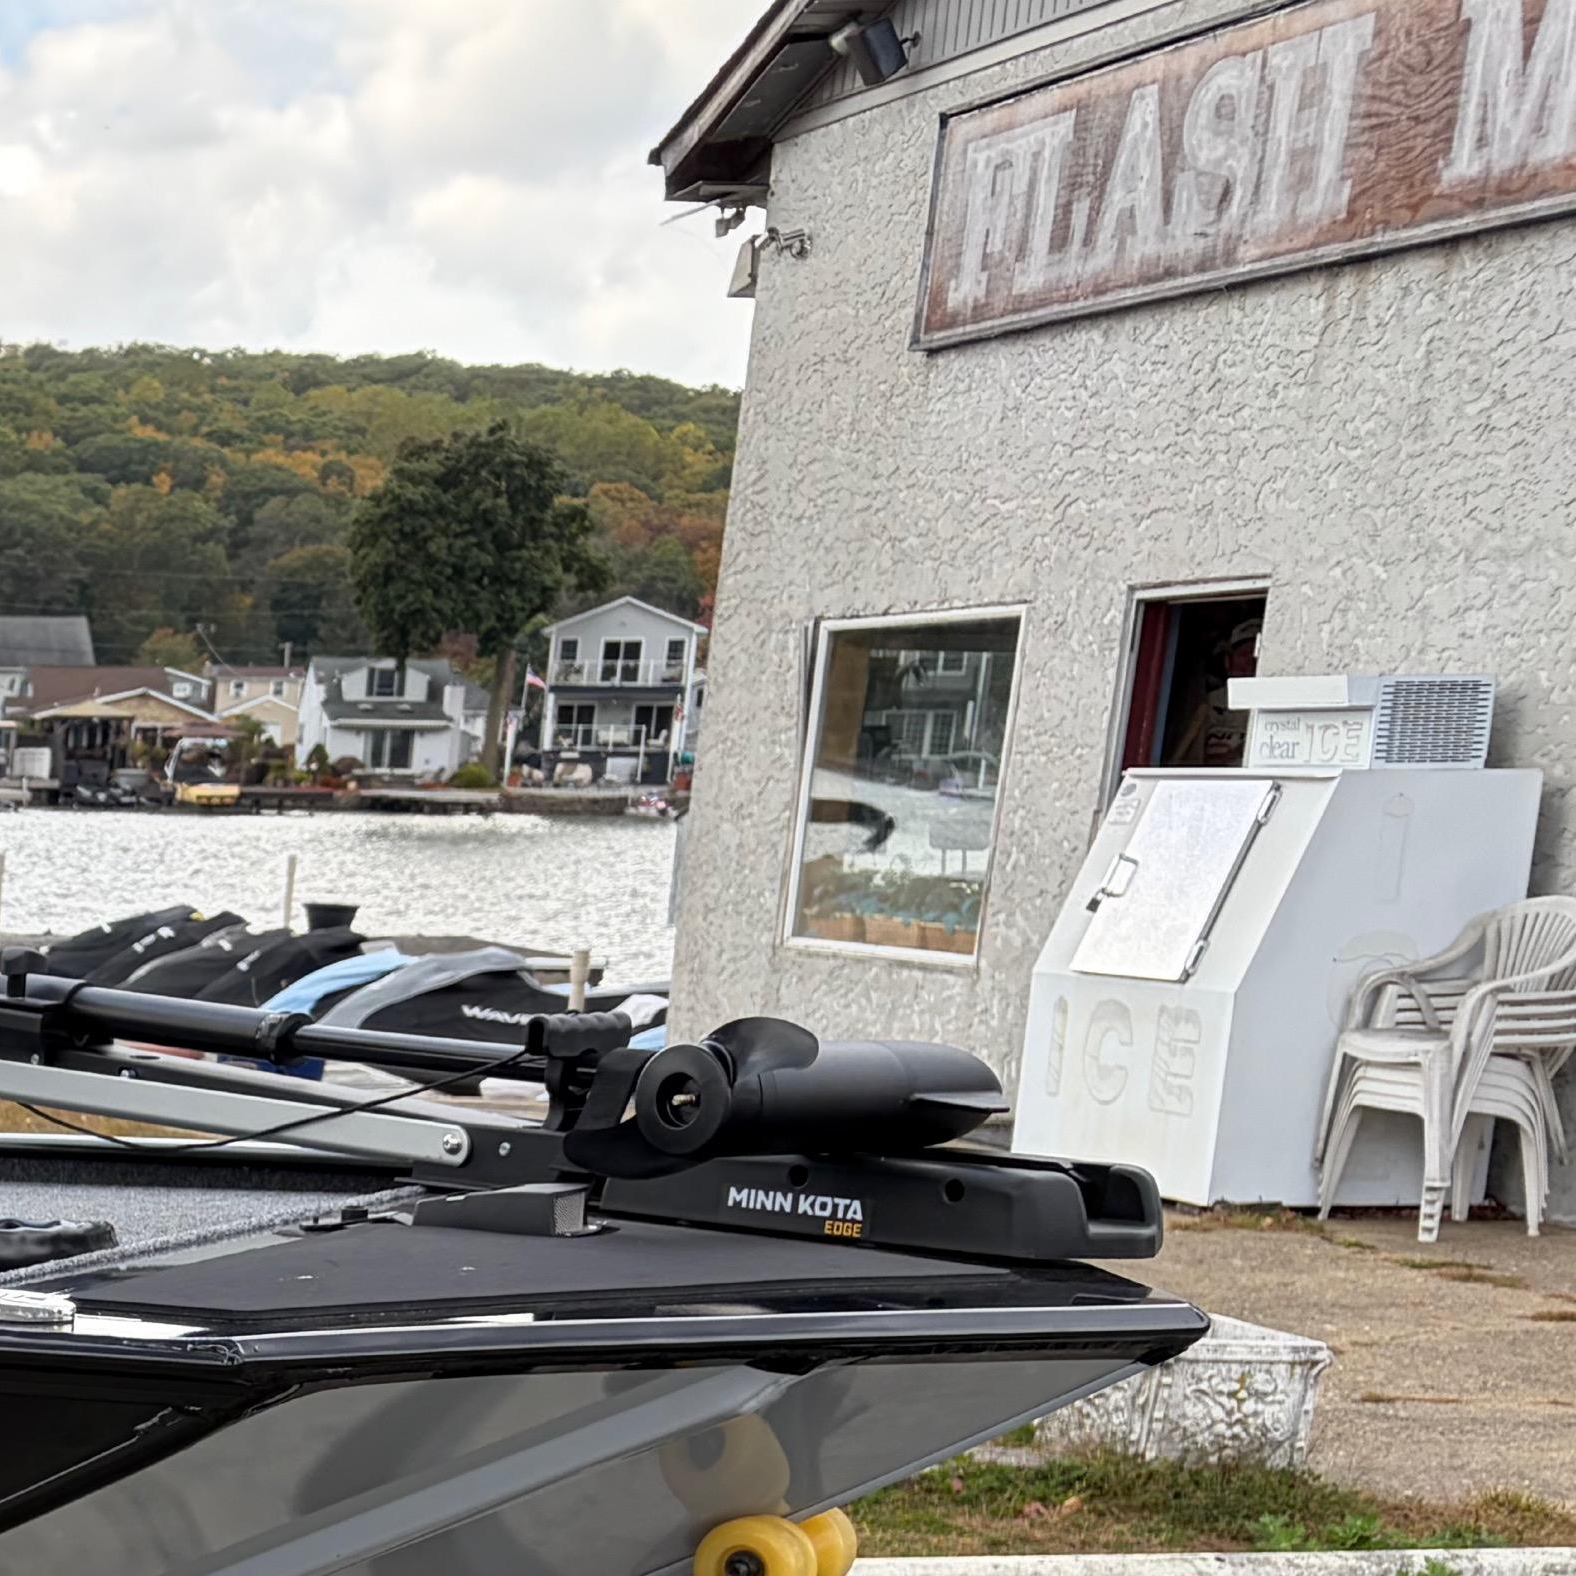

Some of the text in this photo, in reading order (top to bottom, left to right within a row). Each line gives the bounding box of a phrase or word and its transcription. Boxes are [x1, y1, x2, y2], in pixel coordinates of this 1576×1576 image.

[951, 14, 1377, 310] FLASH
[1259, 735, 1300, 760] clear
[1303, 719, 1365, 763] ICE
[1264, 717, 1301, 734] crystal
[1045, 995, 1203, 1118] ICE
[728, 1187, 862, 1220] MINN KOTA
[825, 1222, 862, 1238] EDGE
